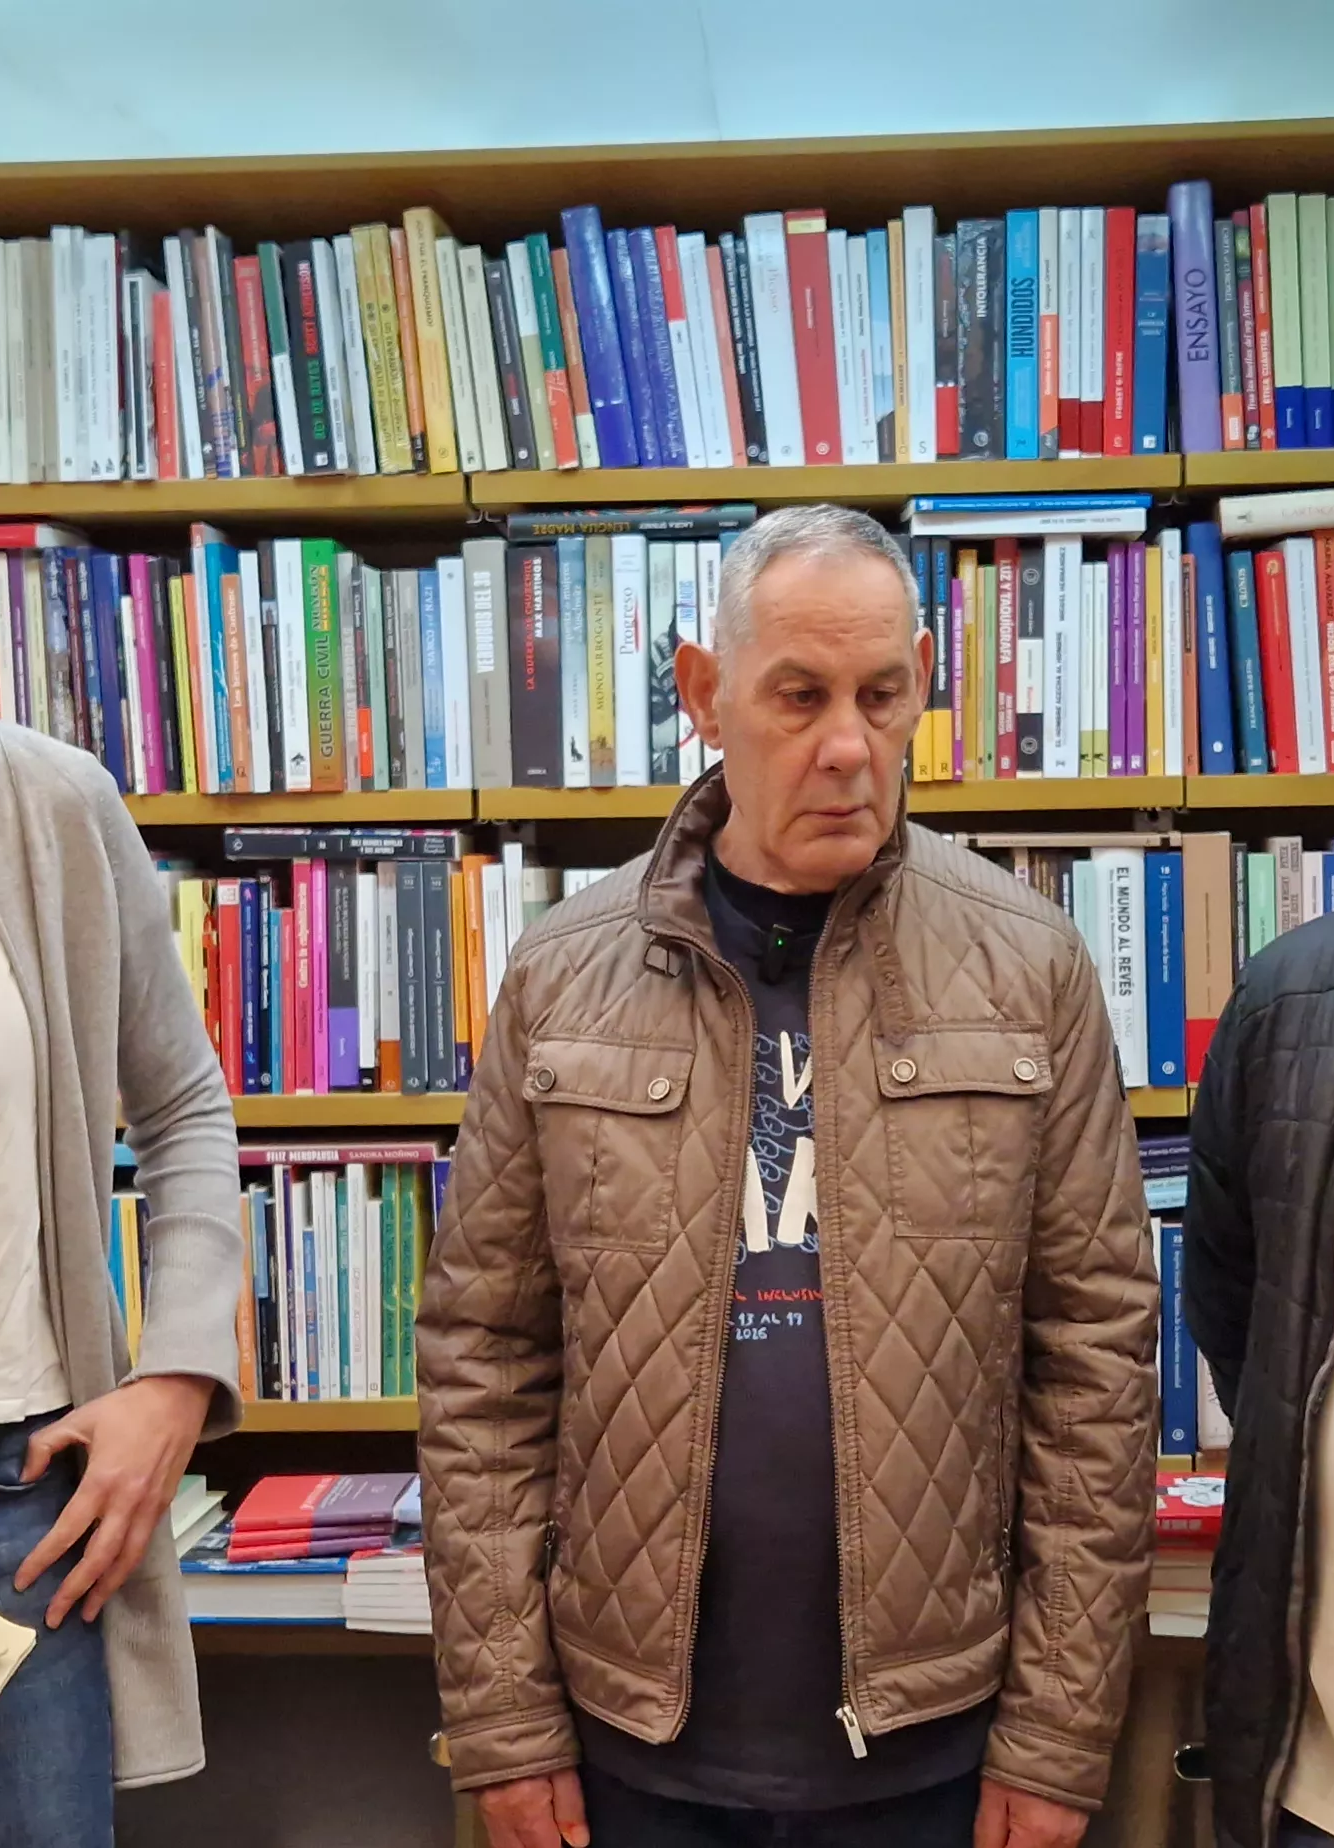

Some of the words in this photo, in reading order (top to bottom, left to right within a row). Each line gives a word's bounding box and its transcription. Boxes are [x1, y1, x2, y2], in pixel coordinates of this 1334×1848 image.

[975, 237, 988, 318] INTOLERANCIA
[1011, 277, 1035, 359] HUNDIDOS
[1183, 268, 1210, 363] ENSAYO
[532, 523, 581, 536] MADRE
[583, 521, 631, 534] LENGUA
[523, 559, 534, 616] CHURCHILL
[532, 556, 543, 611] HASTINGS
[562, 562, 573, 599] mujeres
[999, 559, 1010, 580] LUZ
[999, 582, 1011, 590] Y
[1238, 567, 1248, 608] CRONOS
[228, 587, 239, 635] Canfranc
[424, 585, 435, 612] NAZI
[475, 589, 492, 610] DEL
[534, 613, 543, 638] MAX
[592, 592, 604, 669] ARROGANTE
[619, 586, 634, 655] Progreso
[999, 592, 1014, 665] TAQUÍGRAFA
[230, 638, 240, 649] de
[318, 636, 331, 679] CIVIL
[426, 629, 436, 667] NARCO
[476, 611, 495, 674] VERDUGOS
[525, 634, 535, 674] GUERRA
[230, 652, 241, 687] héroes
[526, 677, 535, 690] LA
[231, 691, 241, 708] Los
[594, 672, 604, 711] MONO
[320, 686, 334, 758] GUERRA
[1117, 866, 1129, 881] EL
[1117, 884, 1130, 934] MUNDO
[1118, 937, 1130, 954] AL
[1119, 957, 1135, 997] REVÉS
[1123, 1008, 1134, 1038] YANG
[267, 1150, 287, 1162] FELIZ
[289, 1149, 340, 1162] MENOPAUSIA
[348, 1150, 382, 1160] SANDRA
[384, 1148, 420, 1159] MOÑINO
[735, 1326, 768, 1341] 2026
[738, 1312, 755, 1327] 13
[761, 1313, 781, 1326] AL
